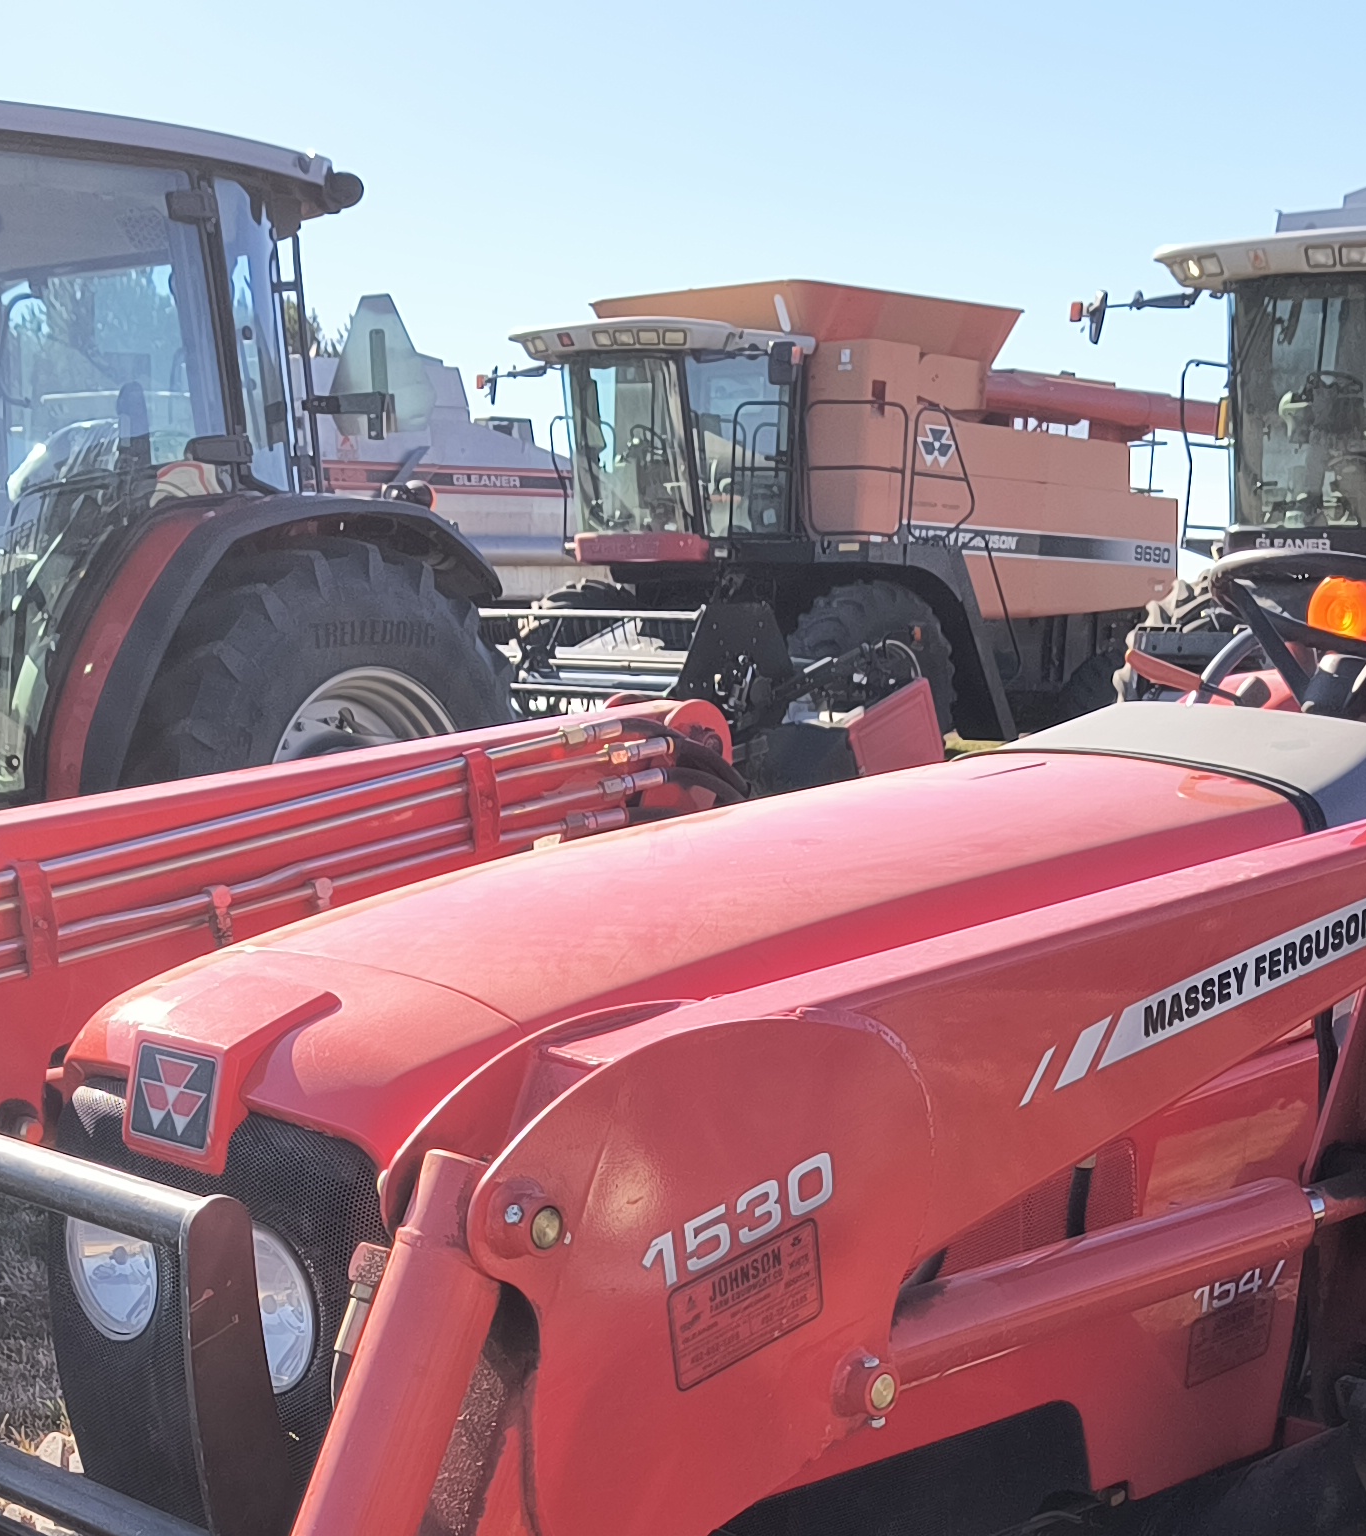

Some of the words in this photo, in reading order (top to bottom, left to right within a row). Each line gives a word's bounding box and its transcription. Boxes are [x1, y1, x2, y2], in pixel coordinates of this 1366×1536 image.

[452, 474, 521, 489] GLEANER
[1134, 544, 1171, 564] 9690
[1143, 961, 1249, 1038] MASSEY
[642, 1152, 833, 1288] 1530
[707, 1245, 782, 1303] JOHNSON
